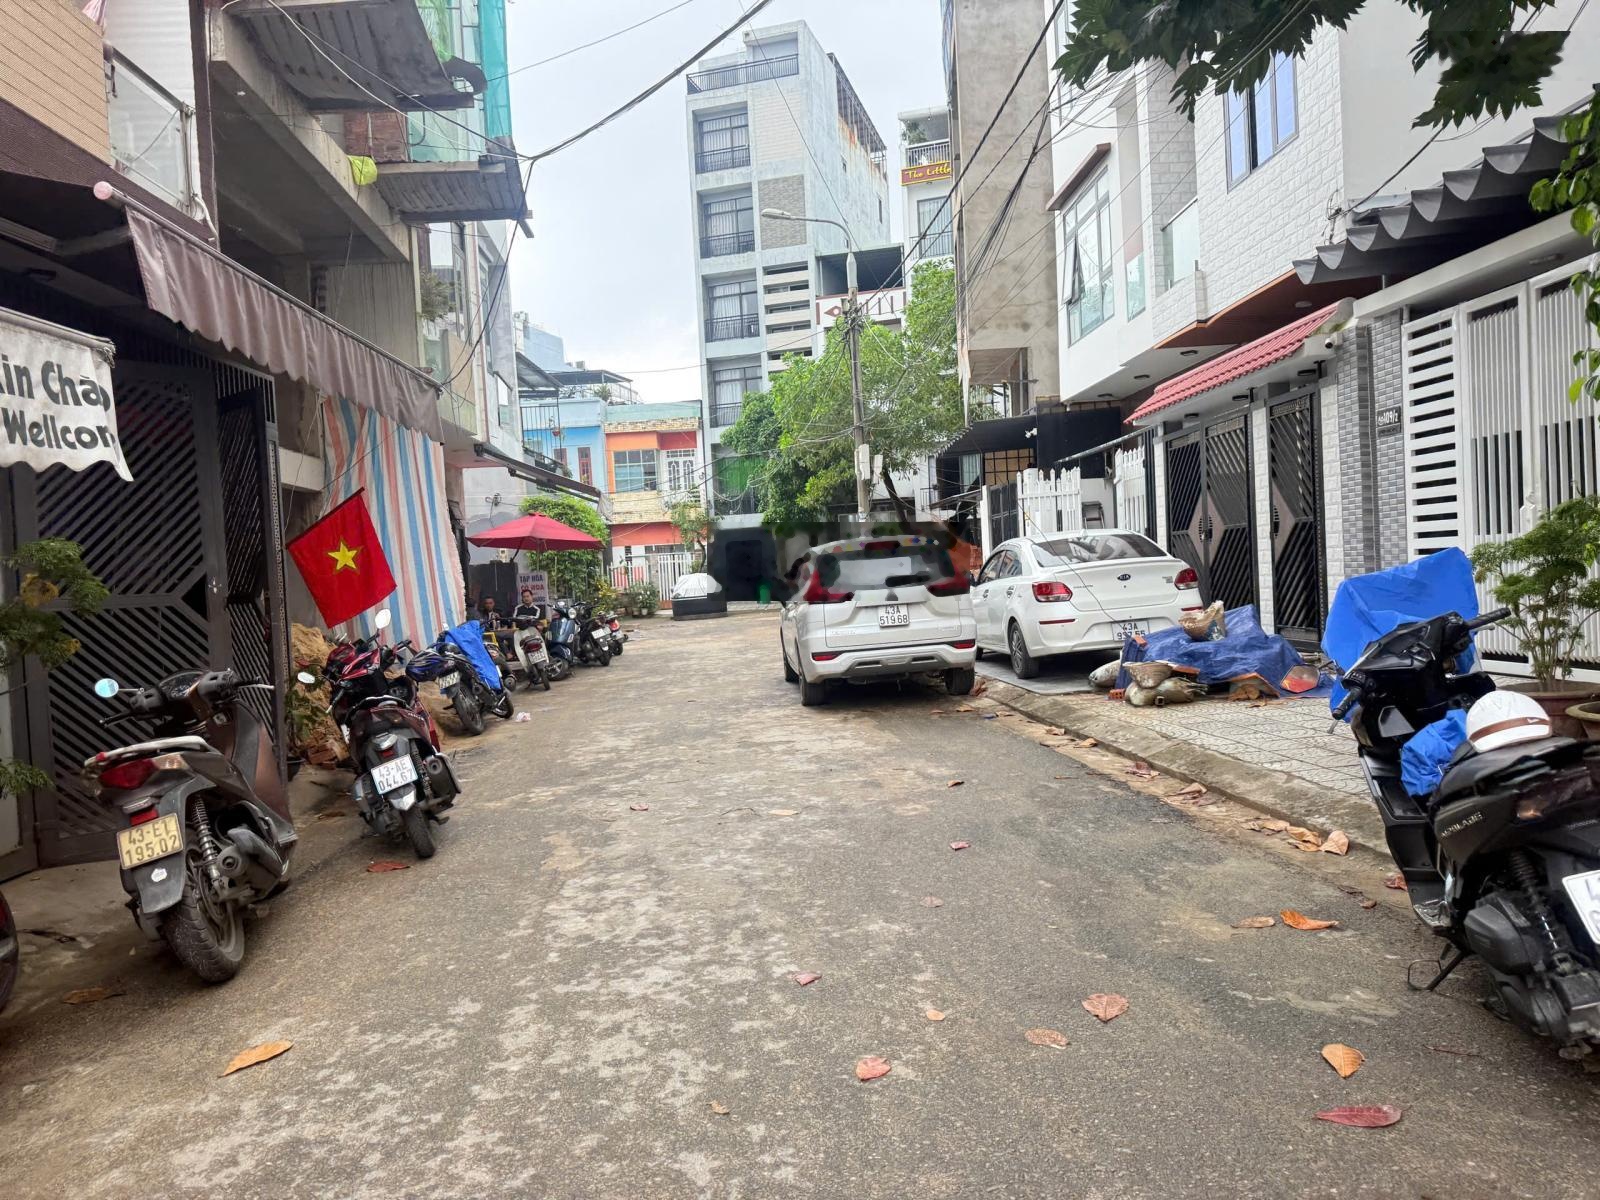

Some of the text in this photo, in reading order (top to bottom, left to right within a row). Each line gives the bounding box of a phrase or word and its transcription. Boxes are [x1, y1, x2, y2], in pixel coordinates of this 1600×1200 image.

[904, 170, 924, 179] The
[0, 353, 35, 399] in
[885, 604, 901, 615] 43A
[128, 819, 170, 845] 43-E1
[125, 834, 178, 865] 195.02
